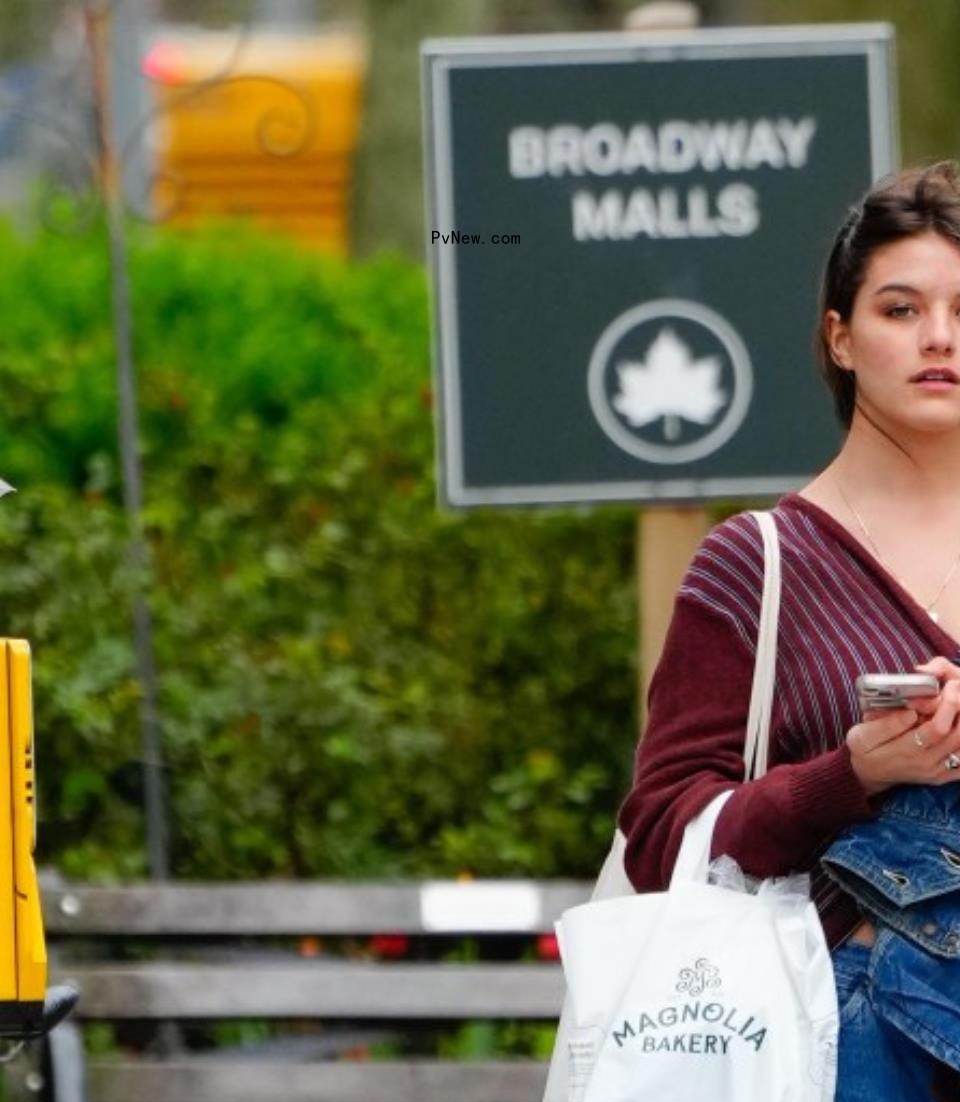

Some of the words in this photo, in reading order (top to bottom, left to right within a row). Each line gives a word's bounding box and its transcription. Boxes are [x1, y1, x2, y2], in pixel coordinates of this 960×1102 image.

[509, 117, 815, 178] BROADWAY
[571, 183, 761, 241] MALLS
[612, 1001, 767, 1052] MAGNOLIA
[642, 1034, 732, 1054] BAKERY
